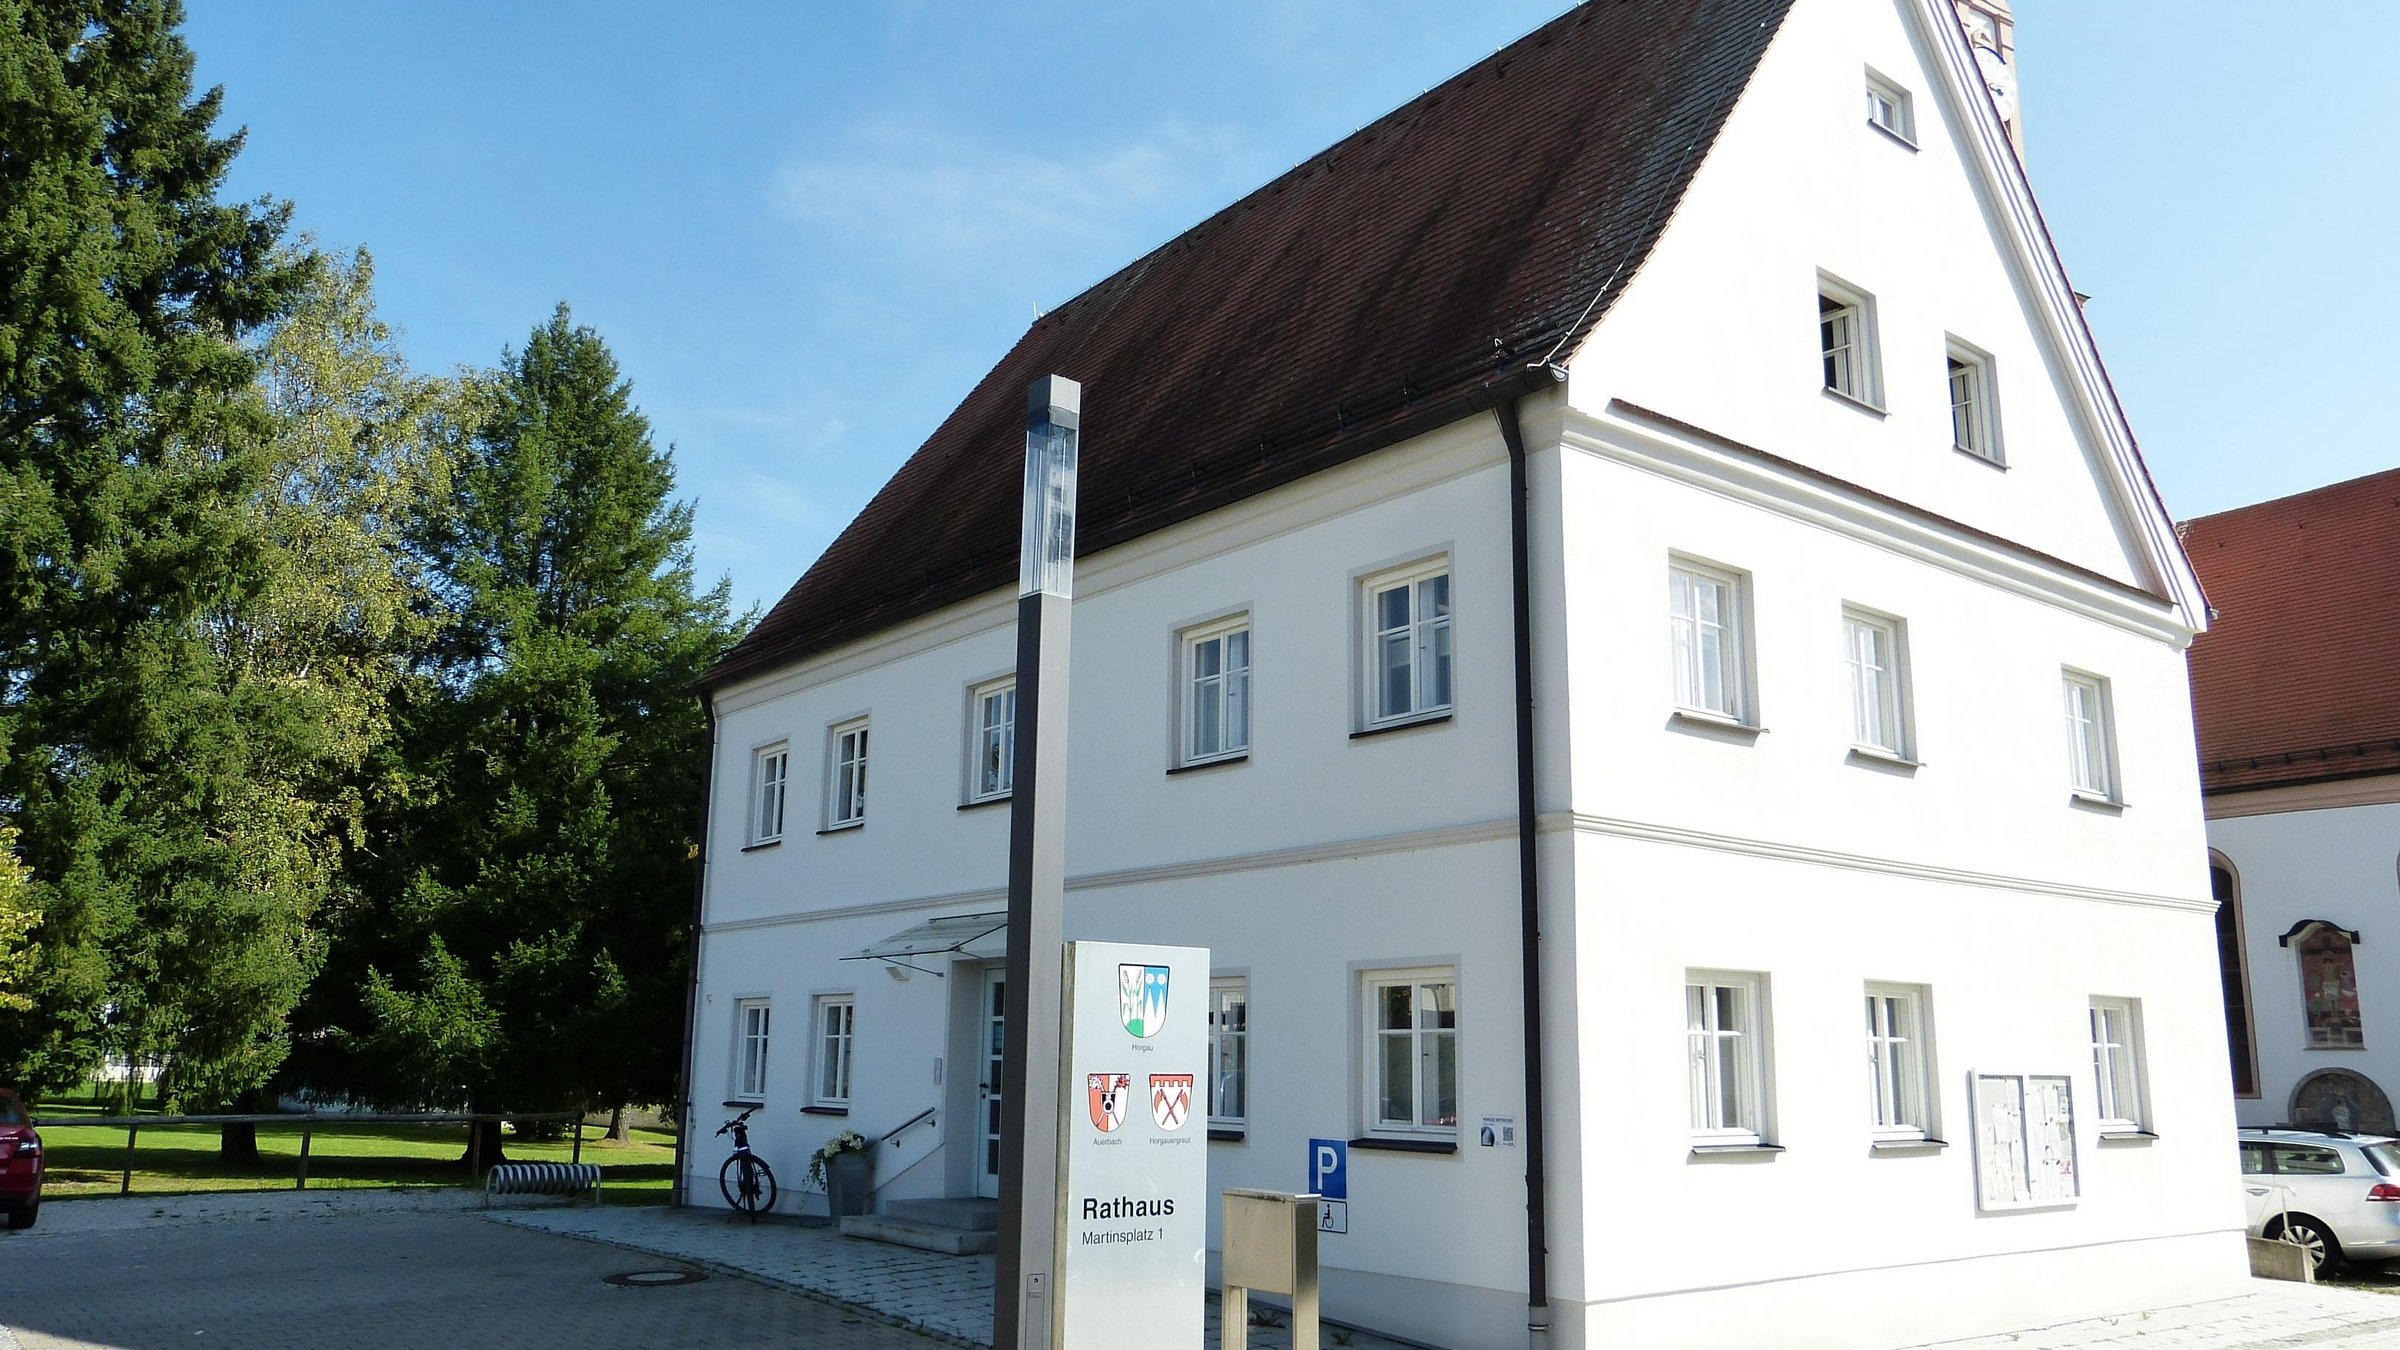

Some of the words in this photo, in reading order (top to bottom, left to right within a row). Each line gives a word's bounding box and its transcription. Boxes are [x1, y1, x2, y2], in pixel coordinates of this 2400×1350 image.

[1131, 1043, 1154, 1053] Horgau
[1093, 1137, 1122, 1146] Auerbach
[1149, 1137, 1191, 1146] Horgauergreut
[1317, 1146, 1338, 1190] P
[1083, 1196, 1175, 1220] Rathaus
[1082, 1228, 1154, 1245] Martinsplatz
[1158, 1227, 1163, 1240] 1
